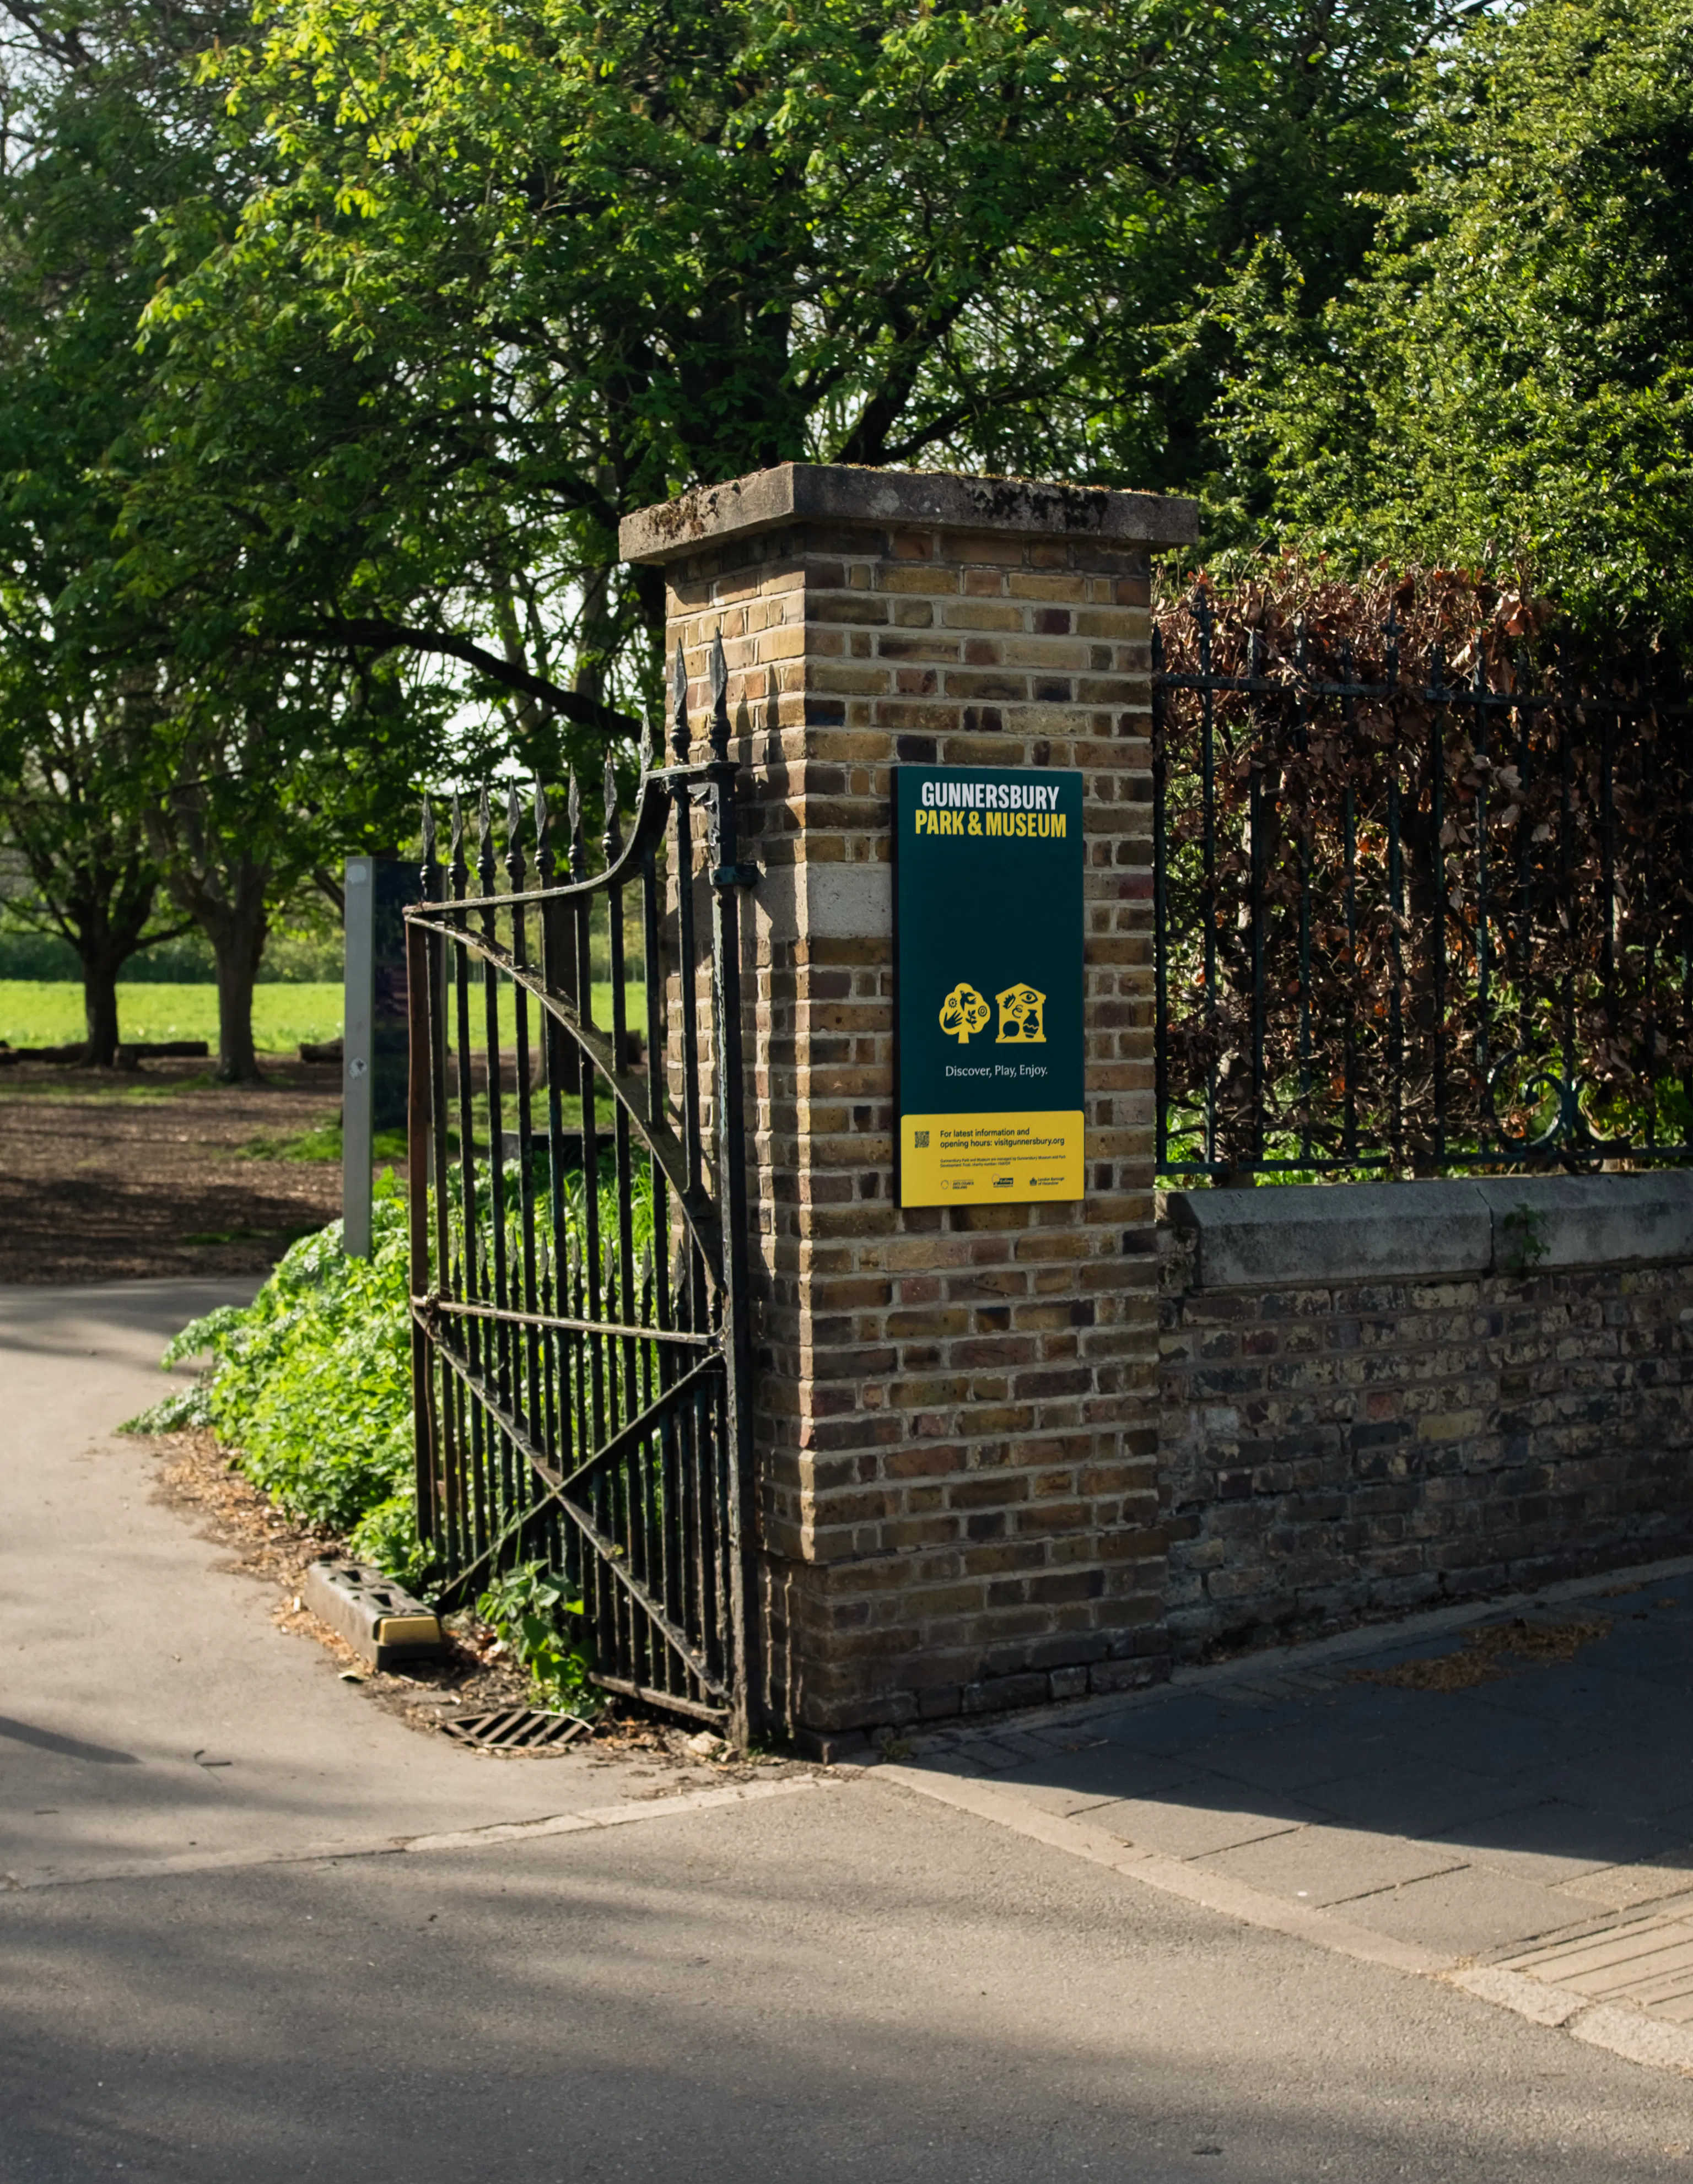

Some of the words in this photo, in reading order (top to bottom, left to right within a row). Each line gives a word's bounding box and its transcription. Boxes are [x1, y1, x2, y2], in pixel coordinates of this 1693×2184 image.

[921, 781, 1060, 810] GUNNERSBURY
[915, 809, 966, 835] PARK
[967, 810, 984, 836] &
[986, 812, 1066, 838] MUSEUM
[946, 1066, 992, 1078] Discover,
[995, 1064, 1017, 1078] Play,
[1020, 1064, 1048, 1078] Enjoy.
[953, 1129, 973, 1137] latest
[975, 1128, 1015, 1137] information
[1017, 1127, 1029, 1136] and
[940, 1139, 968, 1149] opening
[970, 1138, 992, 1147] hours:
[994, 1137, 1065, 1148] visitgunnersbury.org
